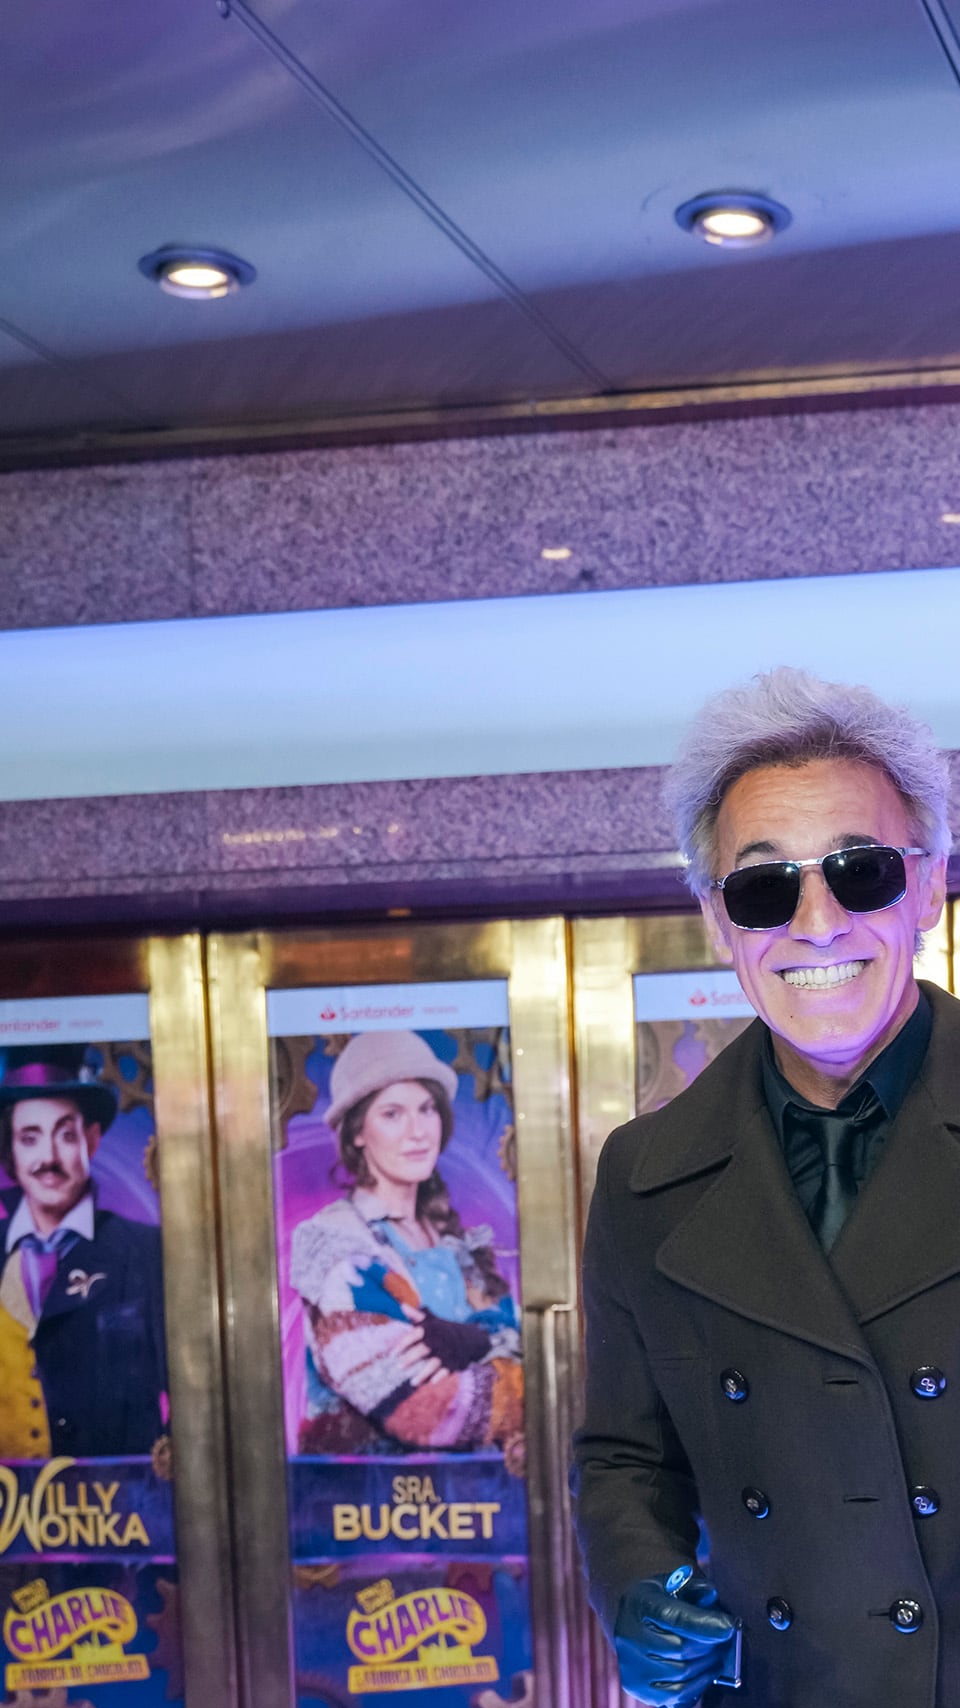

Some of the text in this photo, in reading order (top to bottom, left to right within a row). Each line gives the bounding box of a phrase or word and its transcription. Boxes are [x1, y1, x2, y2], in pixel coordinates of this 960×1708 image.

[392, 1475, 441, 1504] SRA.
[333, 1503, 501, 1541] BUCKET
[10, 1594, 128, 1653] CHARLIE
[353, 1594, 478, 1656] CHARLIE
